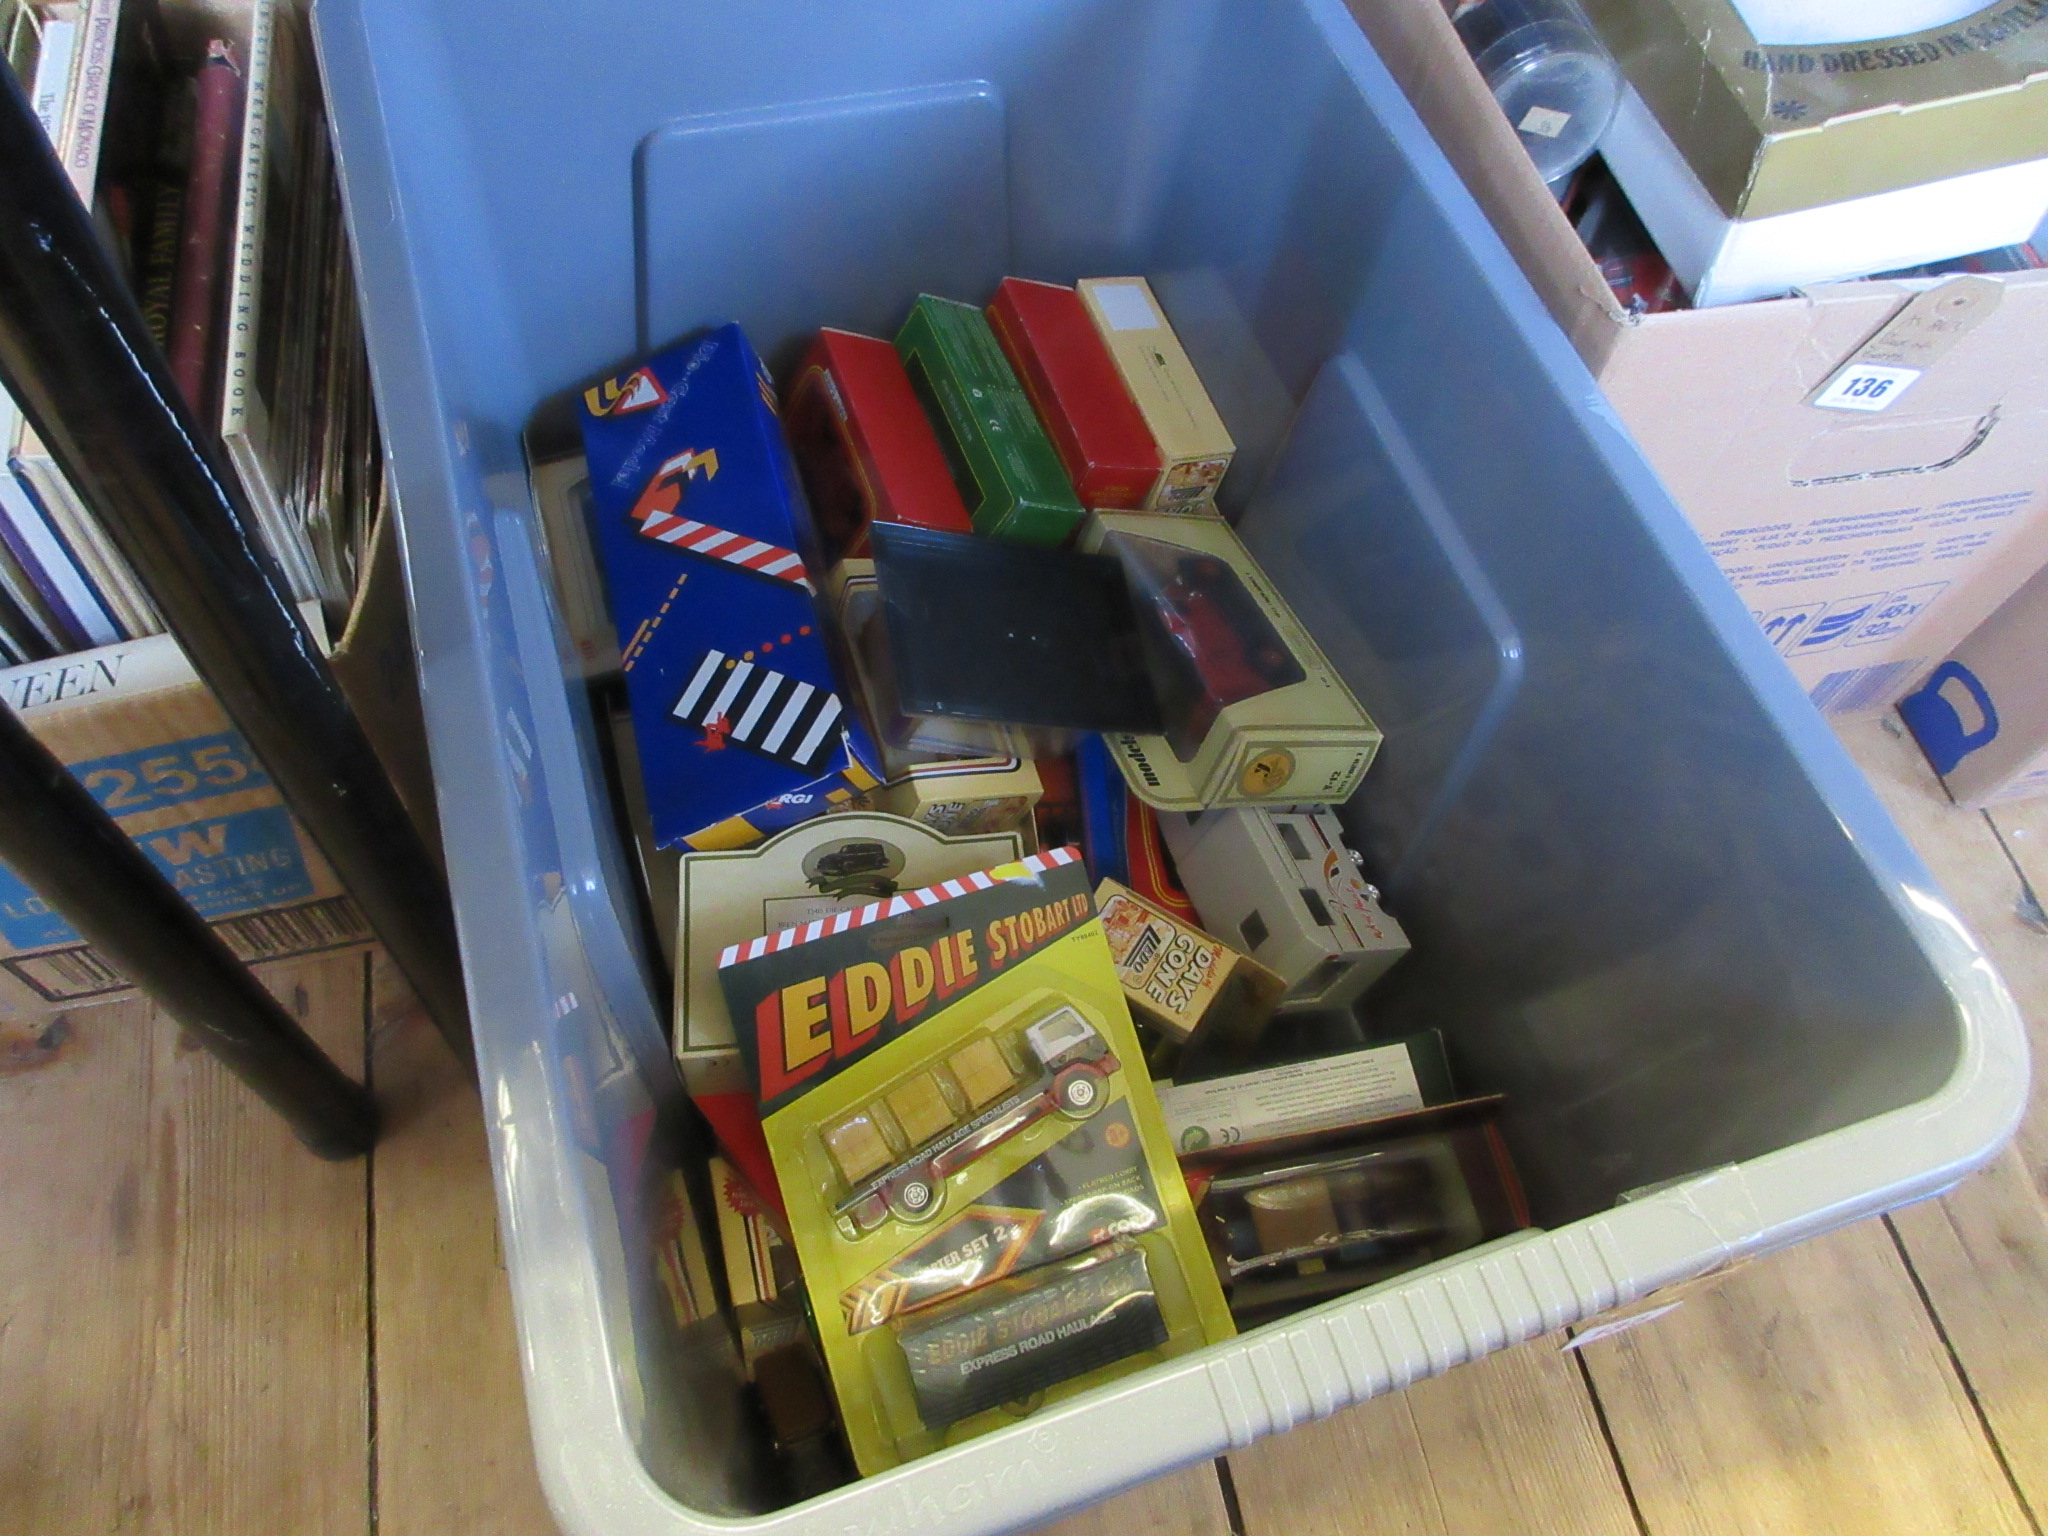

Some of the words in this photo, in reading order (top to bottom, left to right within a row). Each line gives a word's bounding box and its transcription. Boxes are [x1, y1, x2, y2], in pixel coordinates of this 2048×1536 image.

[1821, 42, 1940, 73] DRESSED
[1938, 33, 1974, 55] IN
[237, 224, 255, 331] WEDDING
[231, 350, 246, 416] BOOK
[1842, 377, 1893, 399] 136
[12, 655, 124, 710] EEN
[84, 746, 247, 809] 255
[779, 793, 814, 804] RGI
[175, 847, 292, 889] ASTING
[769, 930, 978, 1082] EDDIE
[985, 899, 1072, 965] STOBART
[1070, 892, 1090, 922] LTD
[1145, 932, 1197, 1005] GONE
[1166, 945, 1214, 1014] DAYS
[870, 1164, 909, 1190] EXPRESS
[908, 1149, 932, 1168] ROAD
[933, 1125, 972, 1153] HAULAGE
[970, 1095, 1021, 1129] SPECIALISTS
[962, 1233, 990, 1258] SET
[993, 1226, 1008, 1243] 2
[960, 1343, 1018, 1375] EXPRESS
[1020, 1329, 1055, 1354] ROAD
